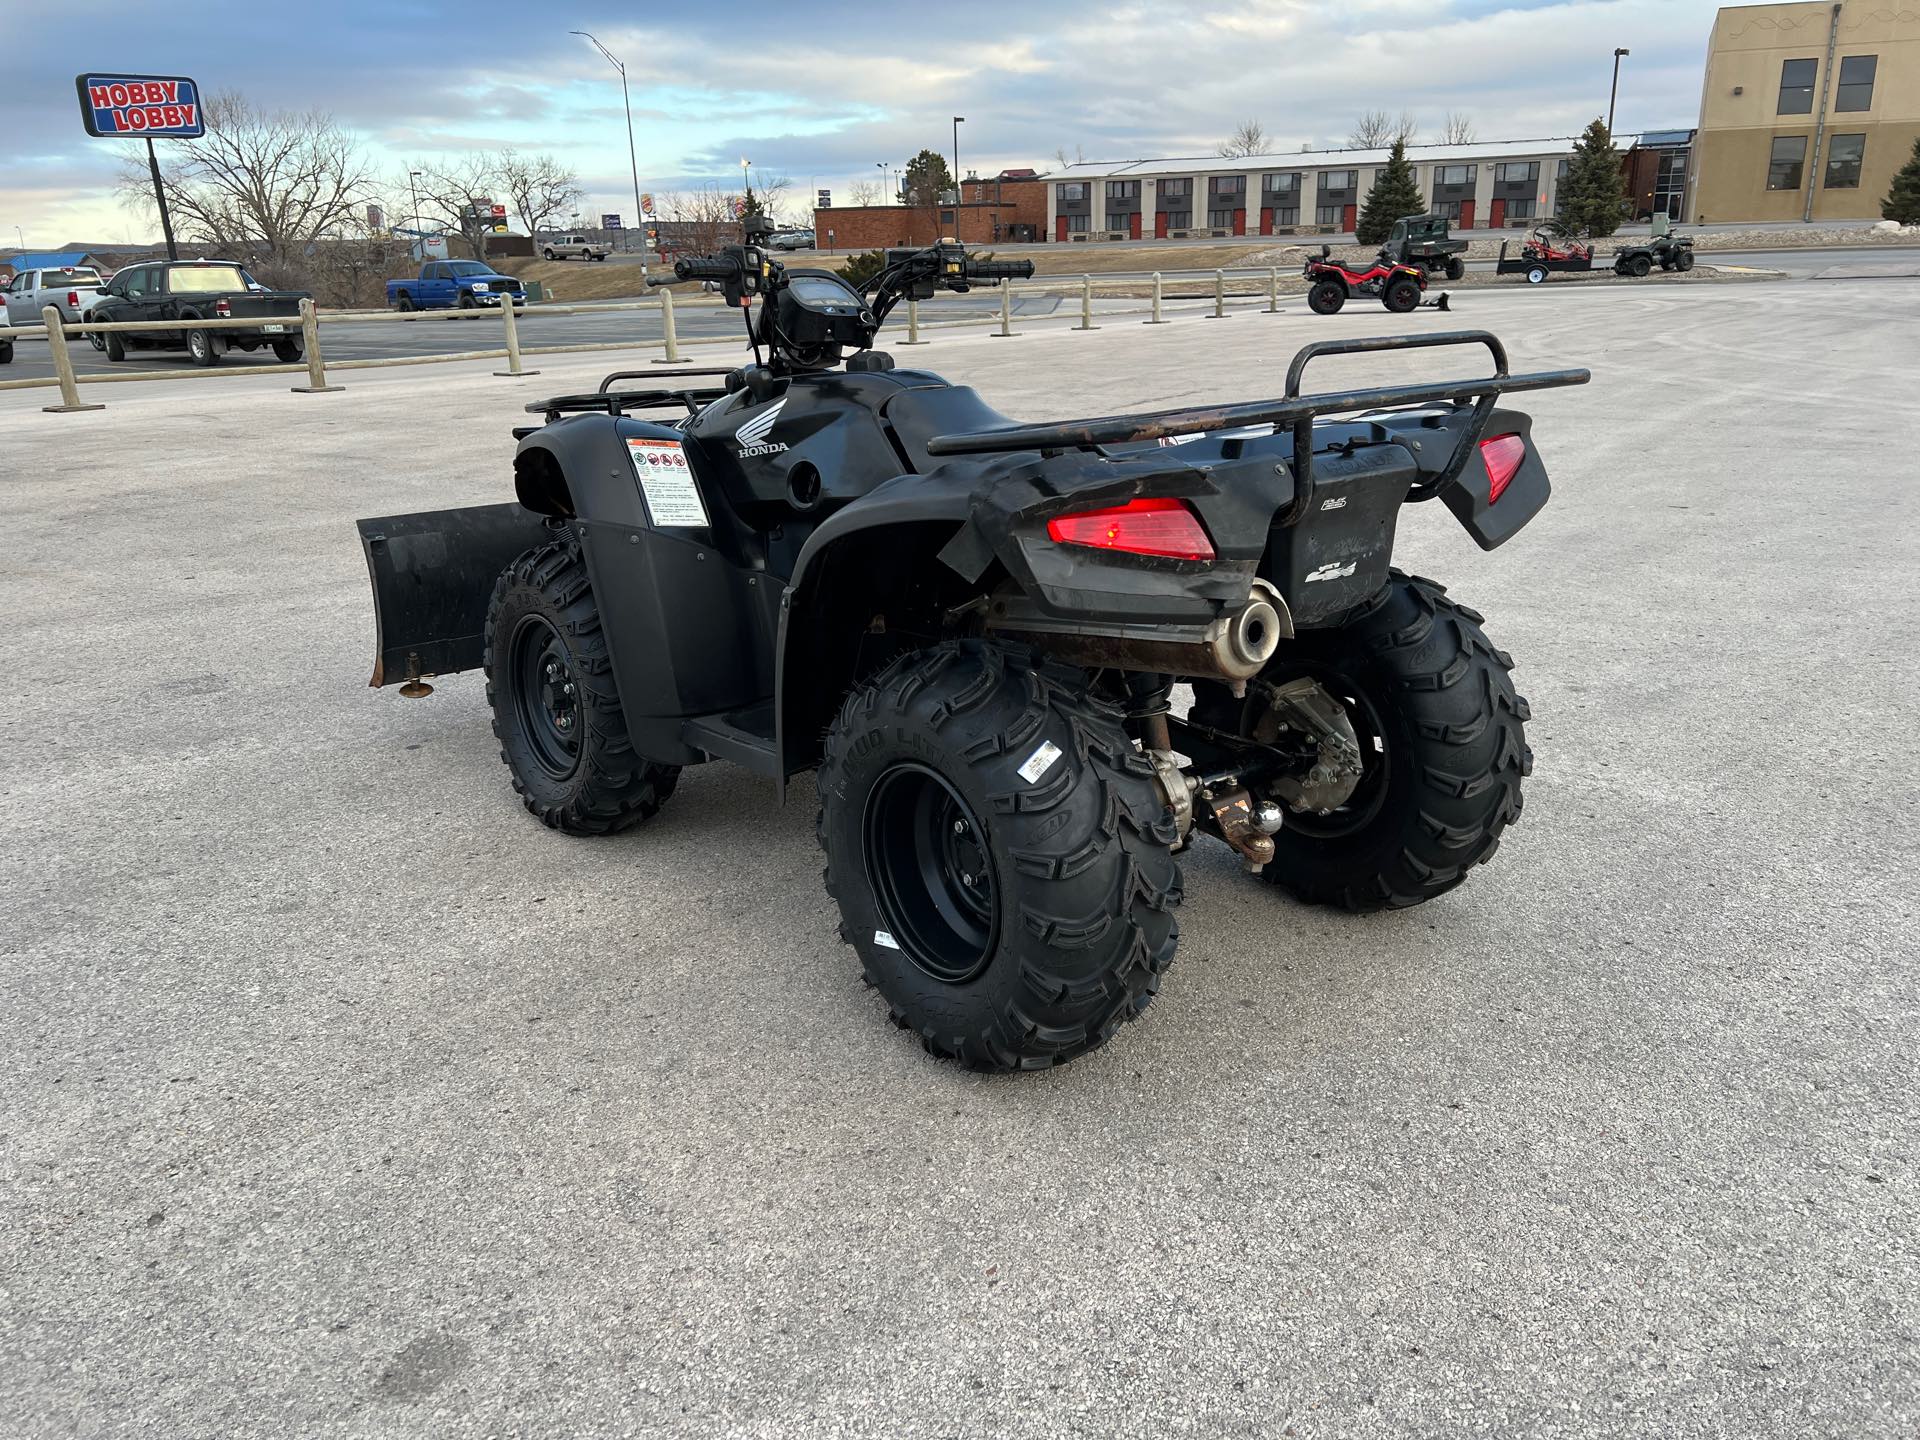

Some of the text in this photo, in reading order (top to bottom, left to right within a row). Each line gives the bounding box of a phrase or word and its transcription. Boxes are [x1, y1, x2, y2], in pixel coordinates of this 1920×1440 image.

[89, 81, 179, 109] HOBBY
[112, 104, 196, 132] LOBBY
[738, 442, 790, 459] HONDA
